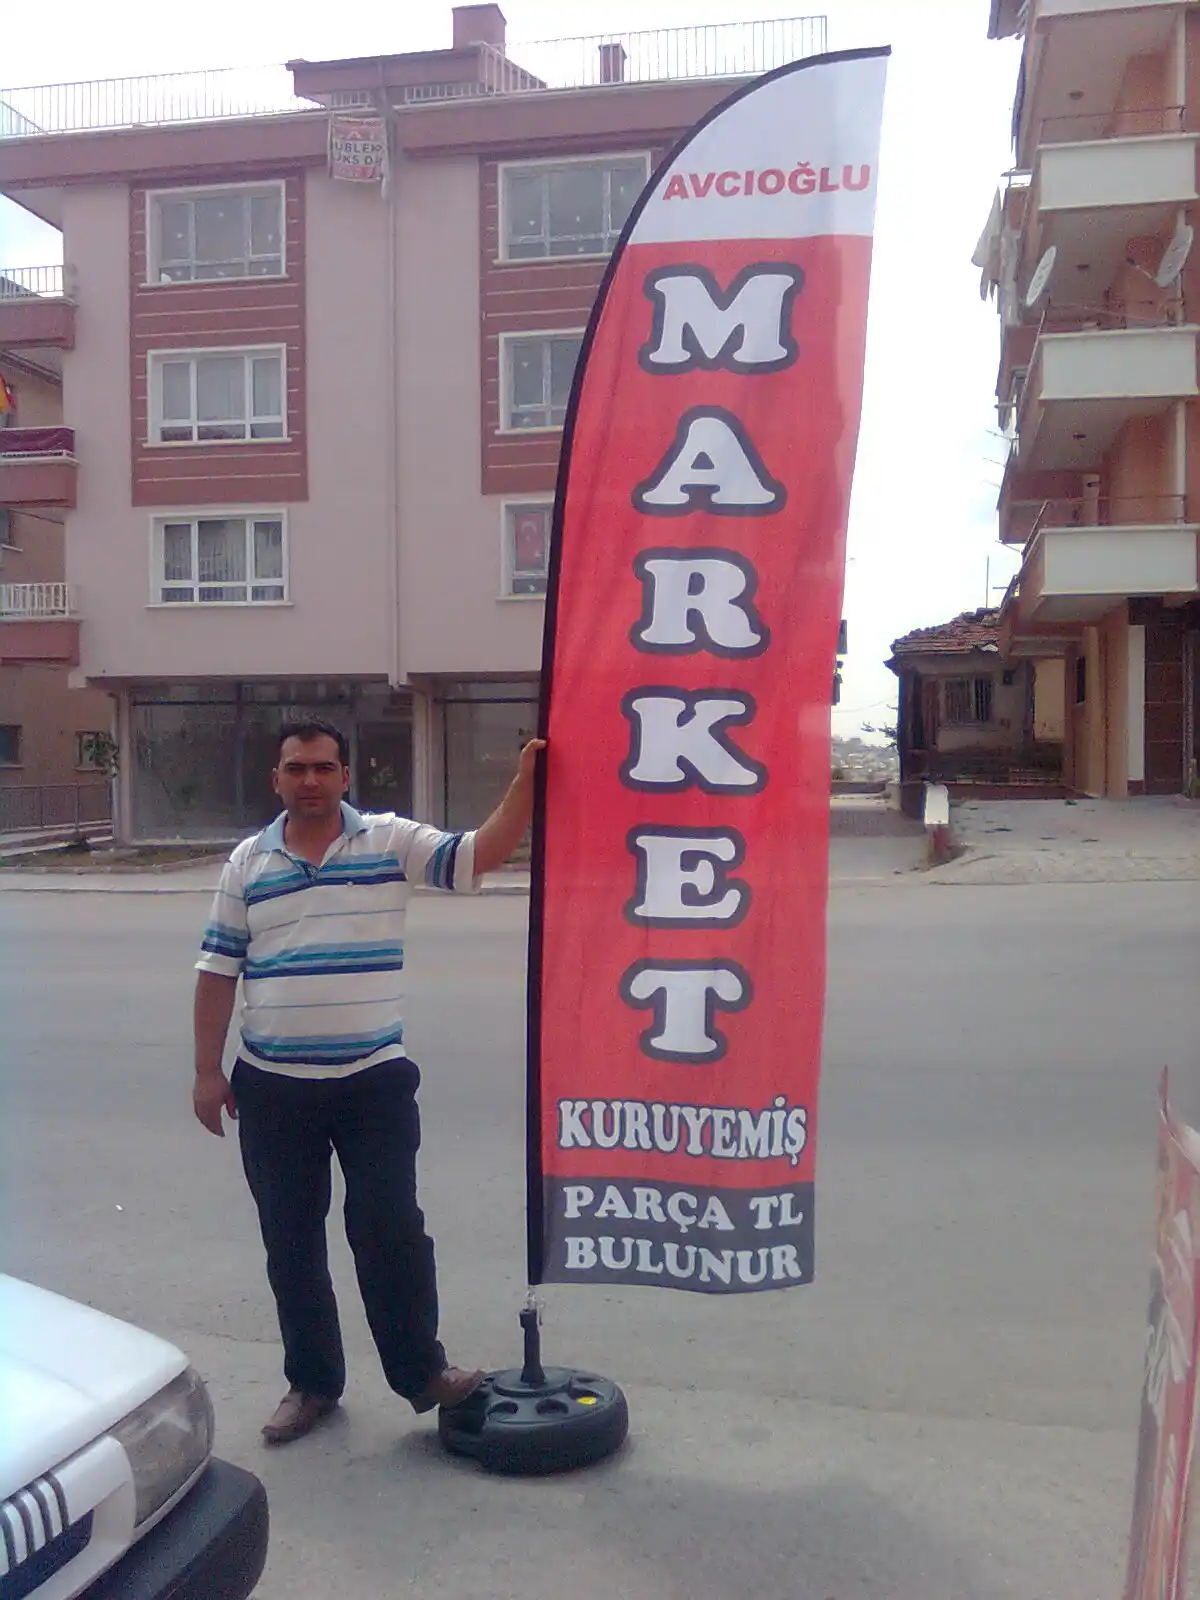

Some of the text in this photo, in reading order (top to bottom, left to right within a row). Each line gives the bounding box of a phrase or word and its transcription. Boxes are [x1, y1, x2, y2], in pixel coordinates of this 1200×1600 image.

[662, 162, 871, 200] AVCIOĞLU
[623, 265, 801, 1059] MARKET
[558, 1096, 807, 1166] KURUYEMİŞ
[563, 1185, 803, 1233] PARÇA TL
[564, 1237, 801, 1284] BULUNUR
